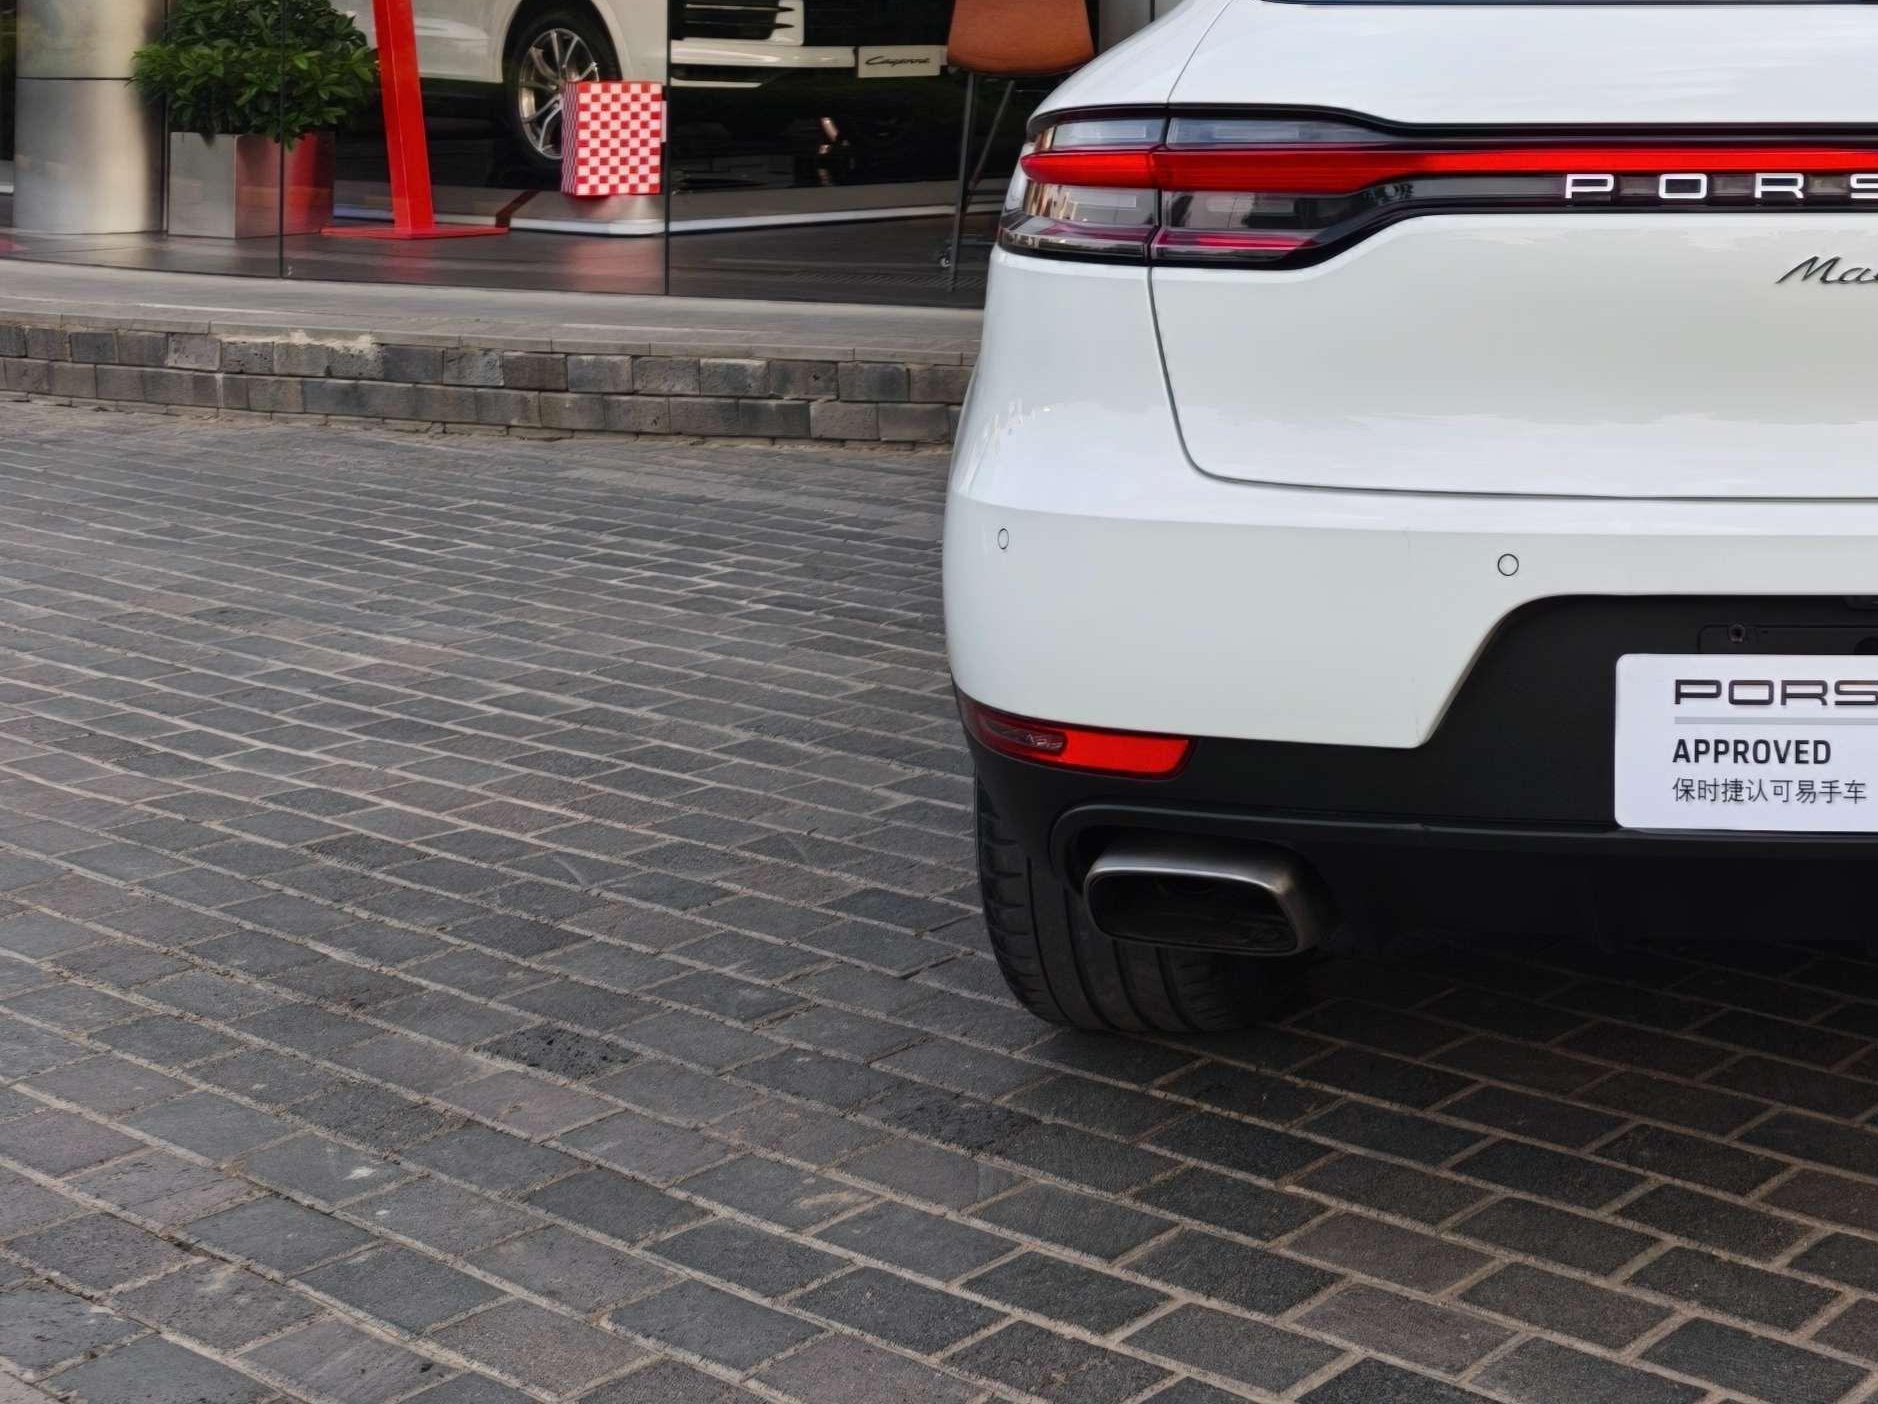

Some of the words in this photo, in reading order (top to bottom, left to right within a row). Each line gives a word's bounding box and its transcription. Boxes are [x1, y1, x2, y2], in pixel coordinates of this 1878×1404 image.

[1672, 739, 1832, 766] APPROVED
[1672, 777, 1867, 804] 保时捷认可易手车
